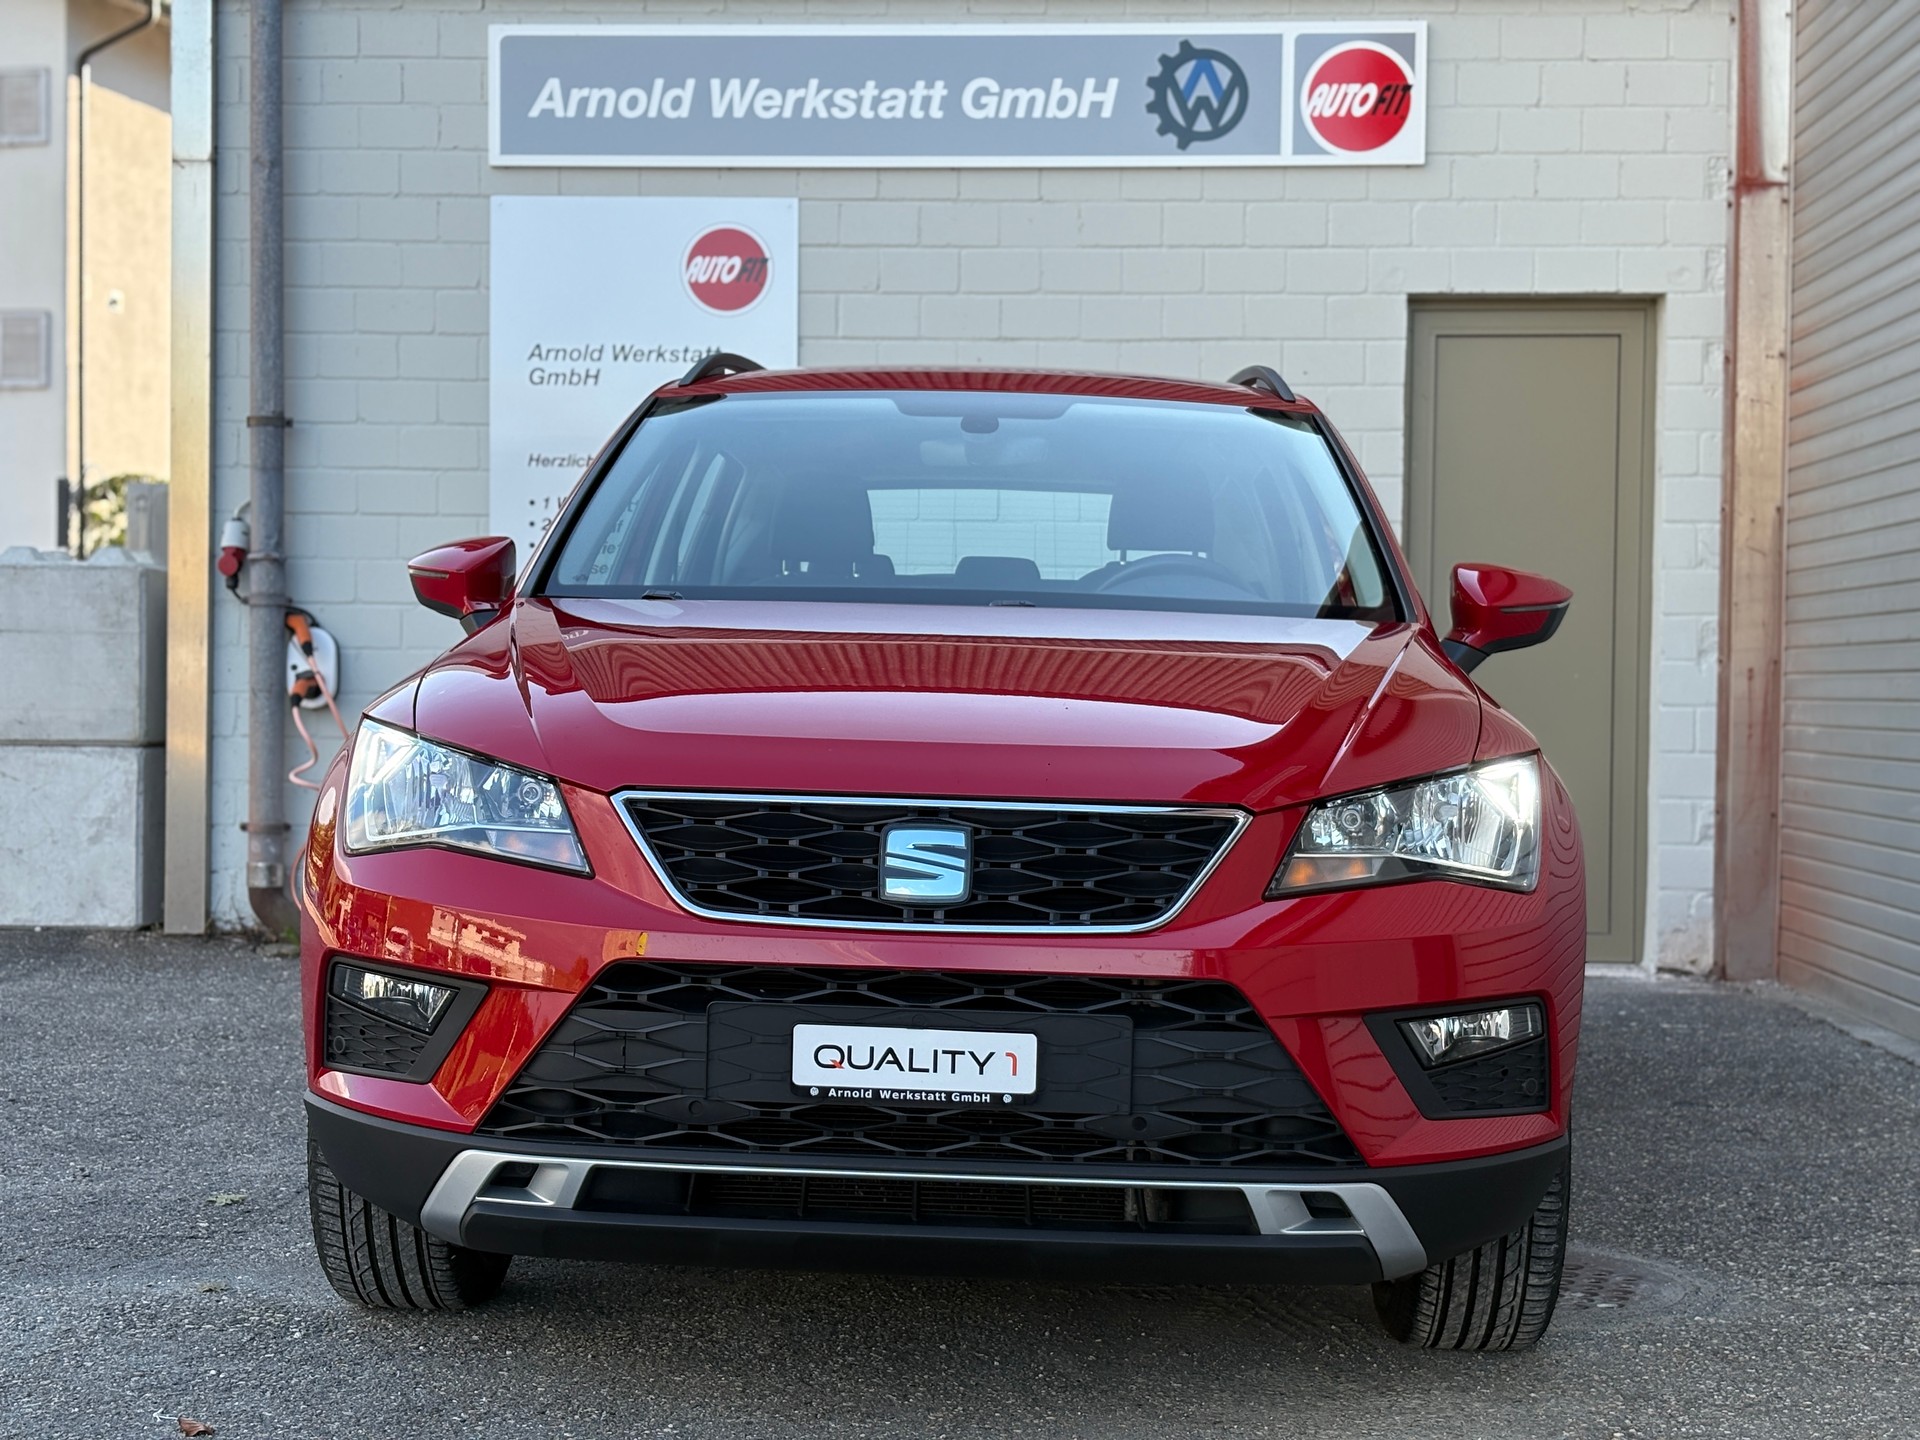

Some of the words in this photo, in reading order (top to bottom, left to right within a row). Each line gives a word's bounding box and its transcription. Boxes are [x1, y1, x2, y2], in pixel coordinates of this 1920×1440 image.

[528, 77, 696, 119] Arnold
[709, 77, 949, 120] Werkstatt
[960, 77, 1120, 120] GmbH
[527, 343, 604, 362] Arnold
[528, 367, 601, 387] GmbH
[813, 1044, 996, 1076] QUALITY
[1005, 1052, 1018, 1077] 1
[828, 1087, 873, 1099] Arnold
[879, 1089, 947, 1103] Werkstatt
[951, 1091, 991, 1103] GmbH
